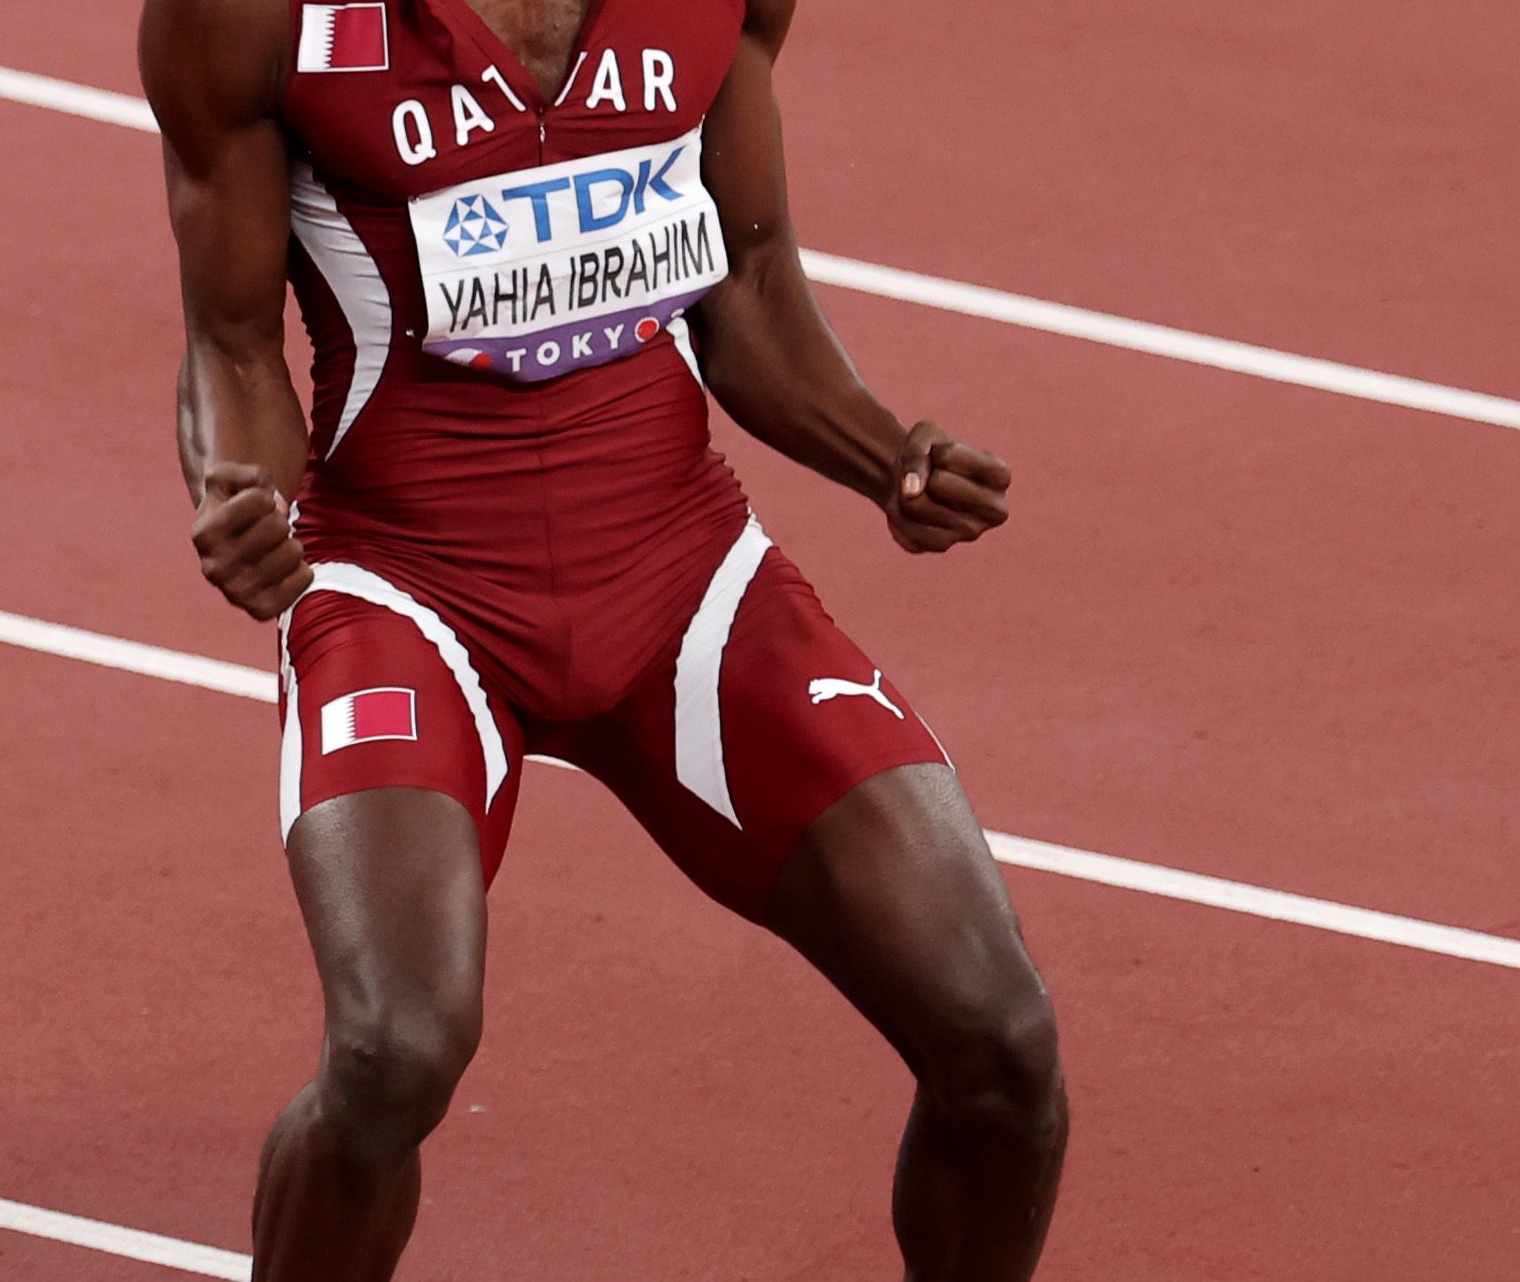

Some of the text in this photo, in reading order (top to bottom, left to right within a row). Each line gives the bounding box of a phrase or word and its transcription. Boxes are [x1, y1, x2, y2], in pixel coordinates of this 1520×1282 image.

[392, 48, 678, 166] QATAR
[502, 144, 689, 244] TDK
[439, 211, 715, 334] YAHIA IBRAHIM
